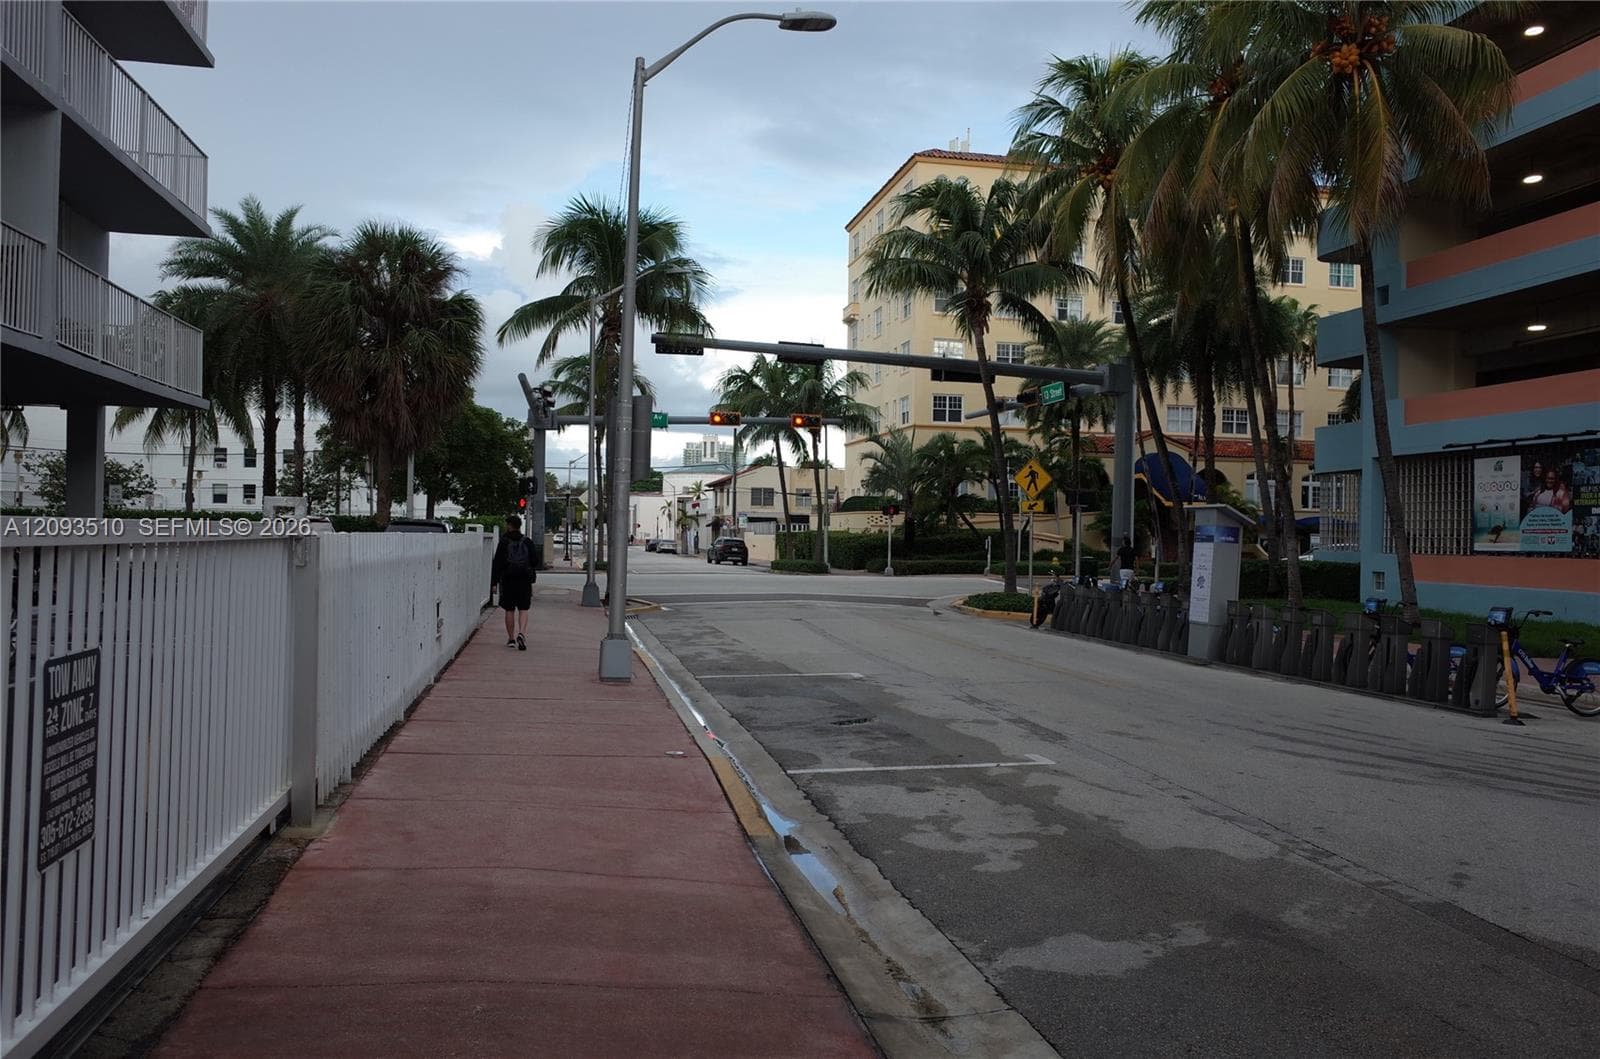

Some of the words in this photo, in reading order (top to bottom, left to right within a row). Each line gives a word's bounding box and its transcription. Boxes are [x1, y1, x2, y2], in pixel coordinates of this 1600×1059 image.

[1049, 384, 1062, 398] Street
[48, 662, 71, 700] TOW
[71, 655, 97, 693] AWAY
[46, 705, 59, 725] 24
[60, 695, 85, 732] ZONE
[89, 693, 94, 708] 7
[46, 723, 59, 738] HRS
[85, 708, 97, 722] DAYS
